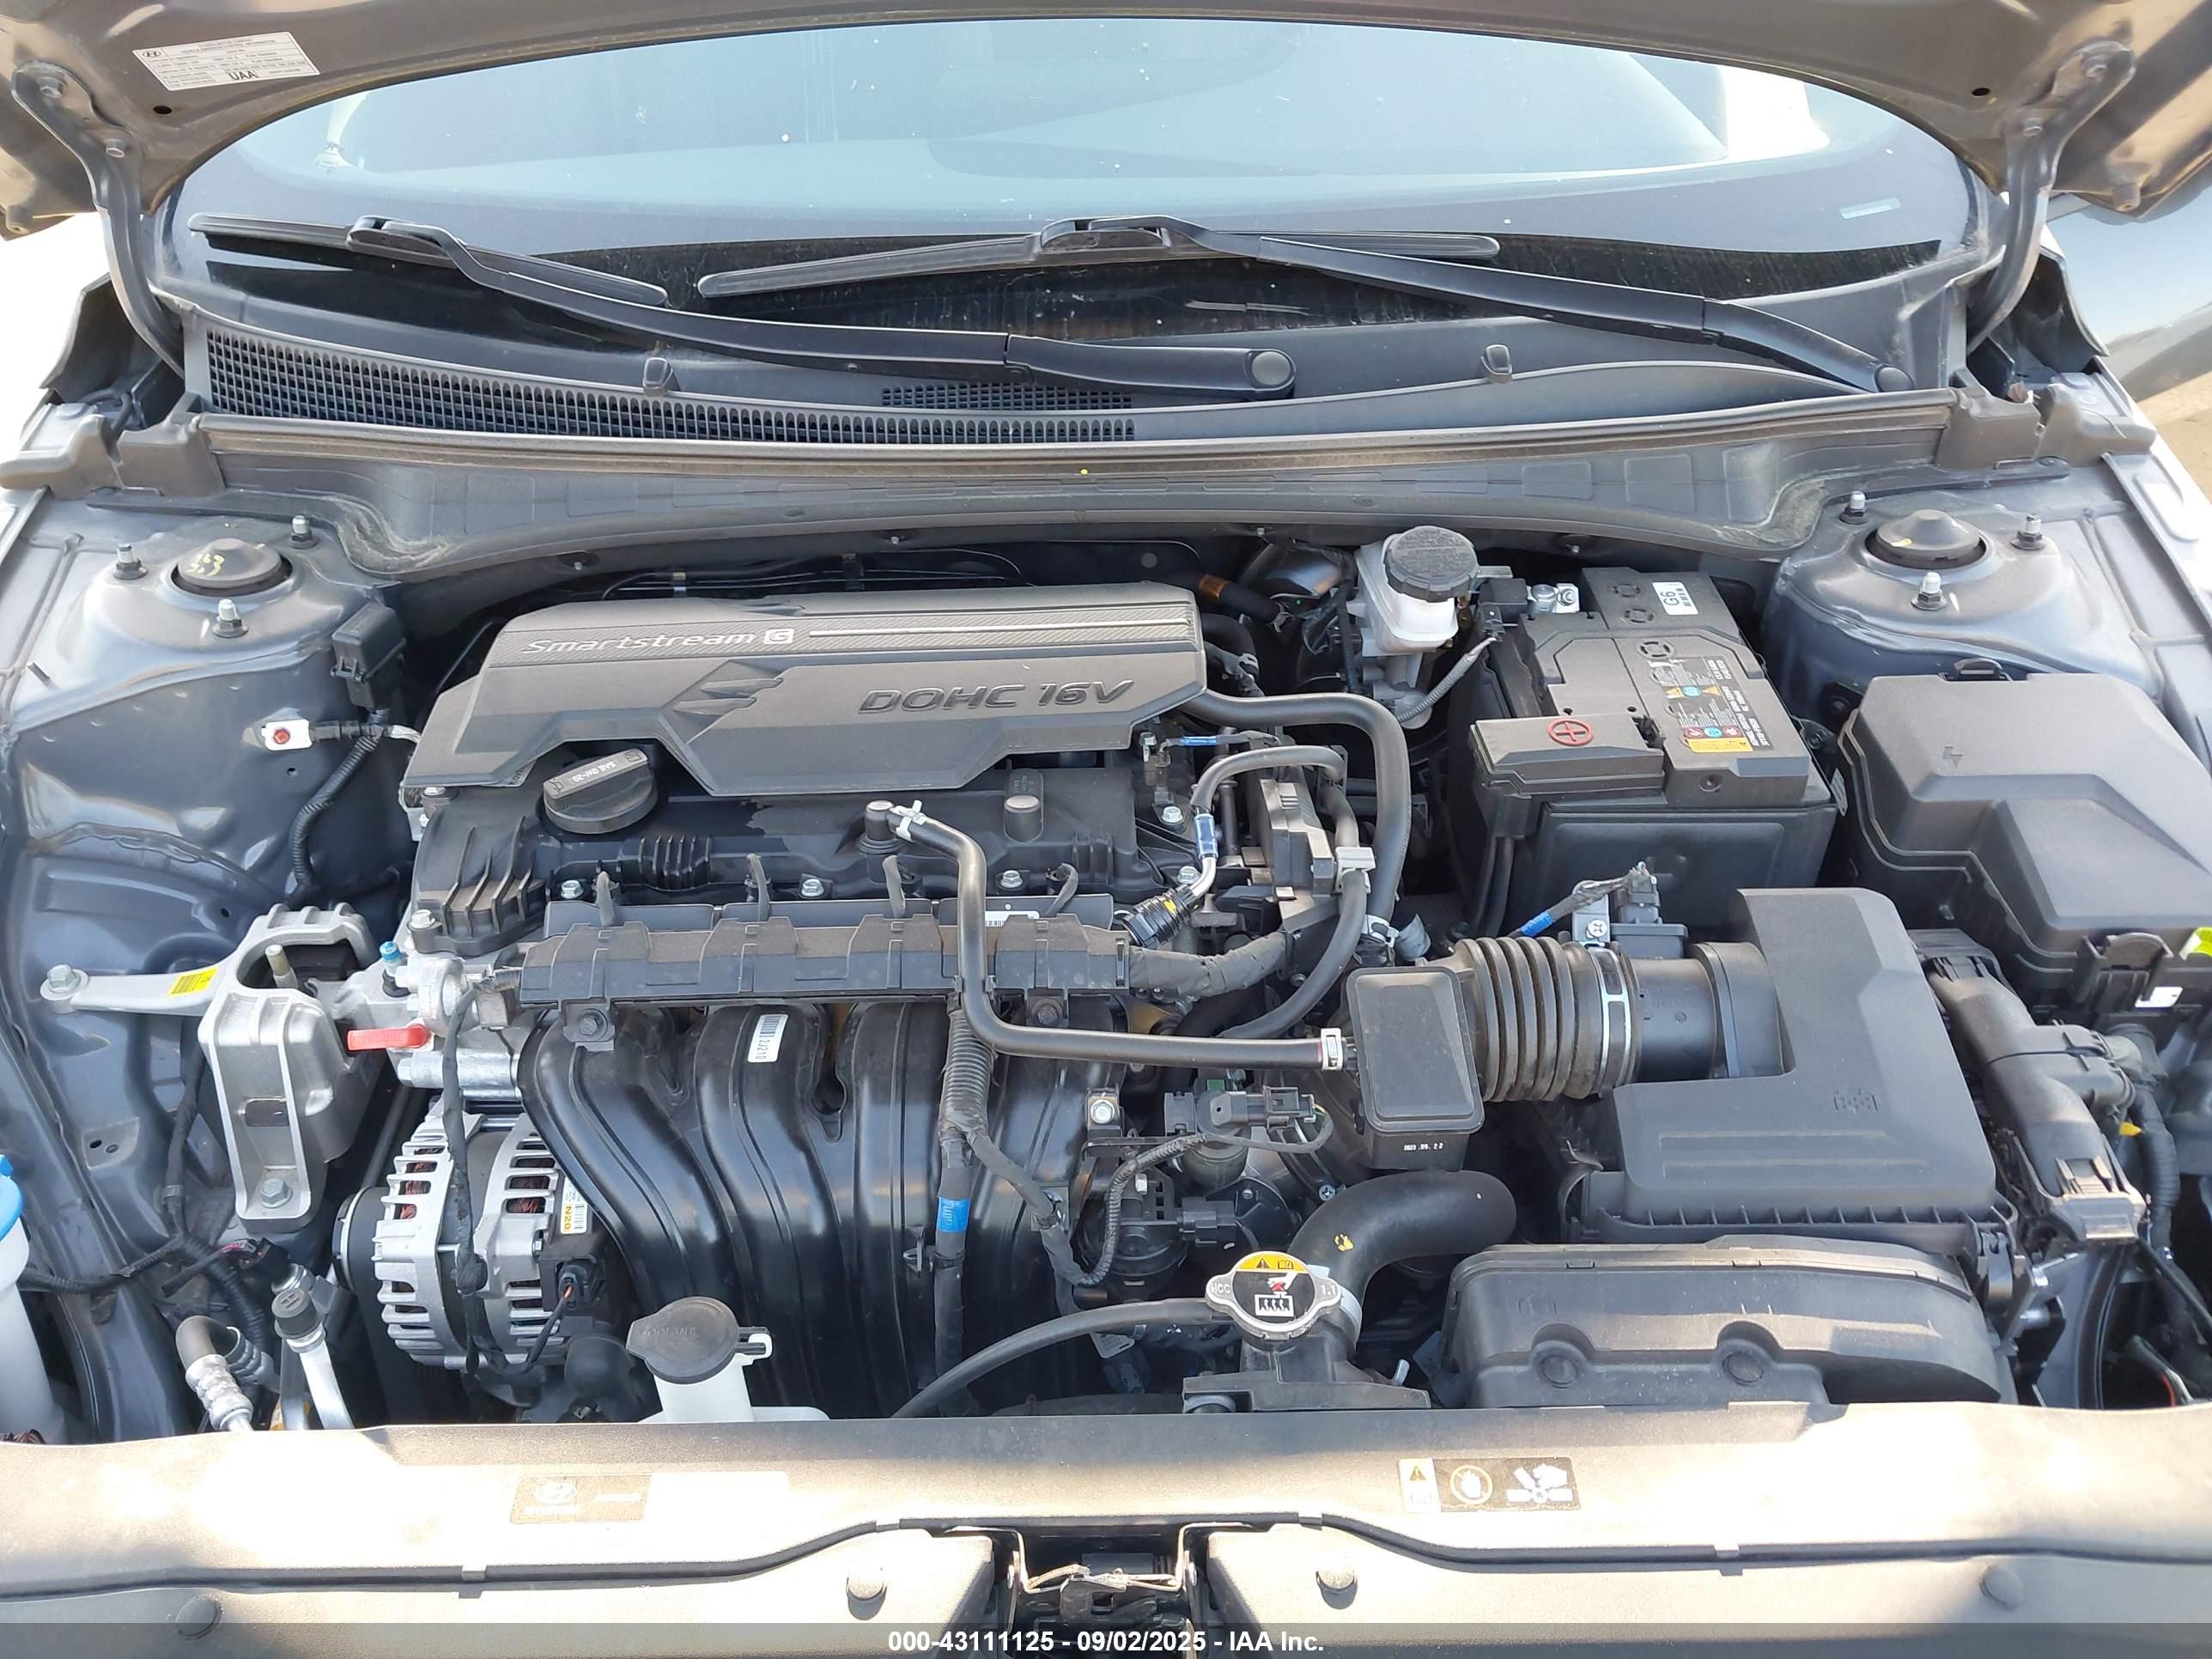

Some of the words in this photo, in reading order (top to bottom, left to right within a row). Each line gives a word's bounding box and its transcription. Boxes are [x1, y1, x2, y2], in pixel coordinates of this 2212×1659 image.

[229, 70, 258, 81] UAA
[1659, 591, 1680, 606] G6
[521, 632, 757, 654] Smartstream
[859, 684, 1025, 714] DOHC
[1037, 679, 1134, 706] 16V
[1321, 1285, 1337, 1296] 1.1
